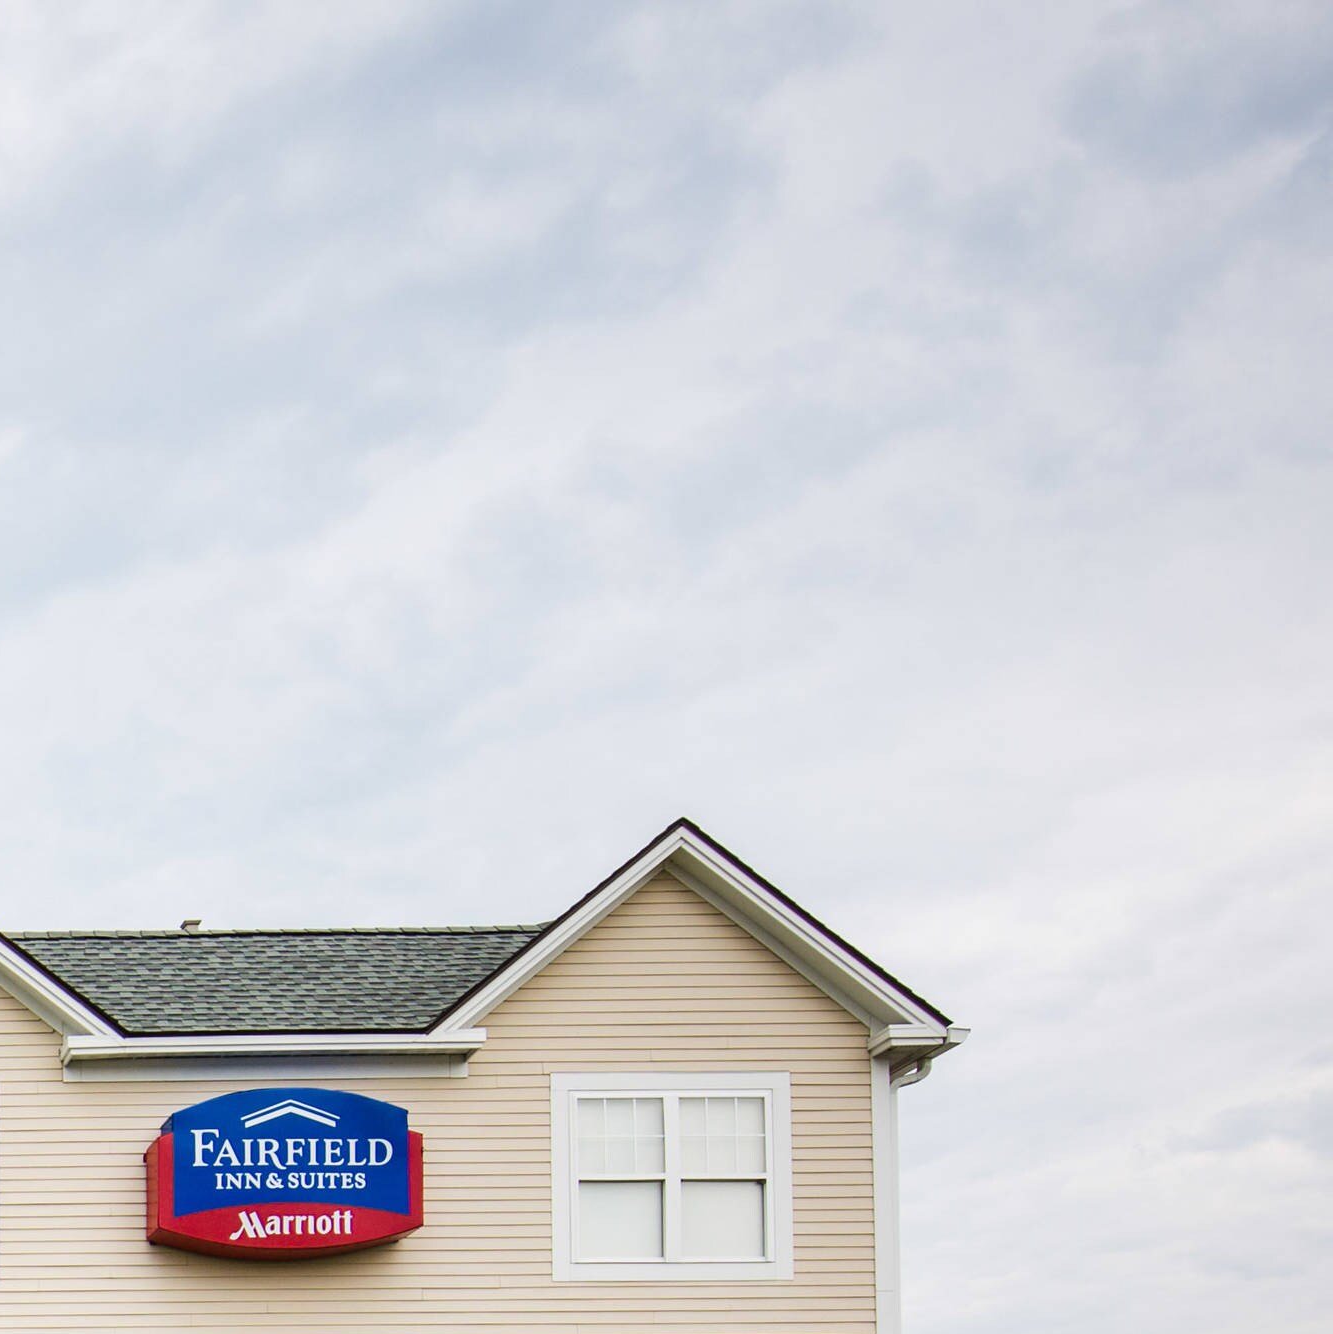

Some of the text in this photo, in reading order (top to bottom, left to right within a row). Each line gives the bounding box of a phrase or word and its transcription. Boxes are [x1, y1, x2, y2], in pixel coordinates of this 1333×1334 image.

[190, 1128, 394, 1170] FAIRFIELD
[215, 1172, 367, 1190] INN & SUITES
[229, 1210, 354, 1241] Marriott
